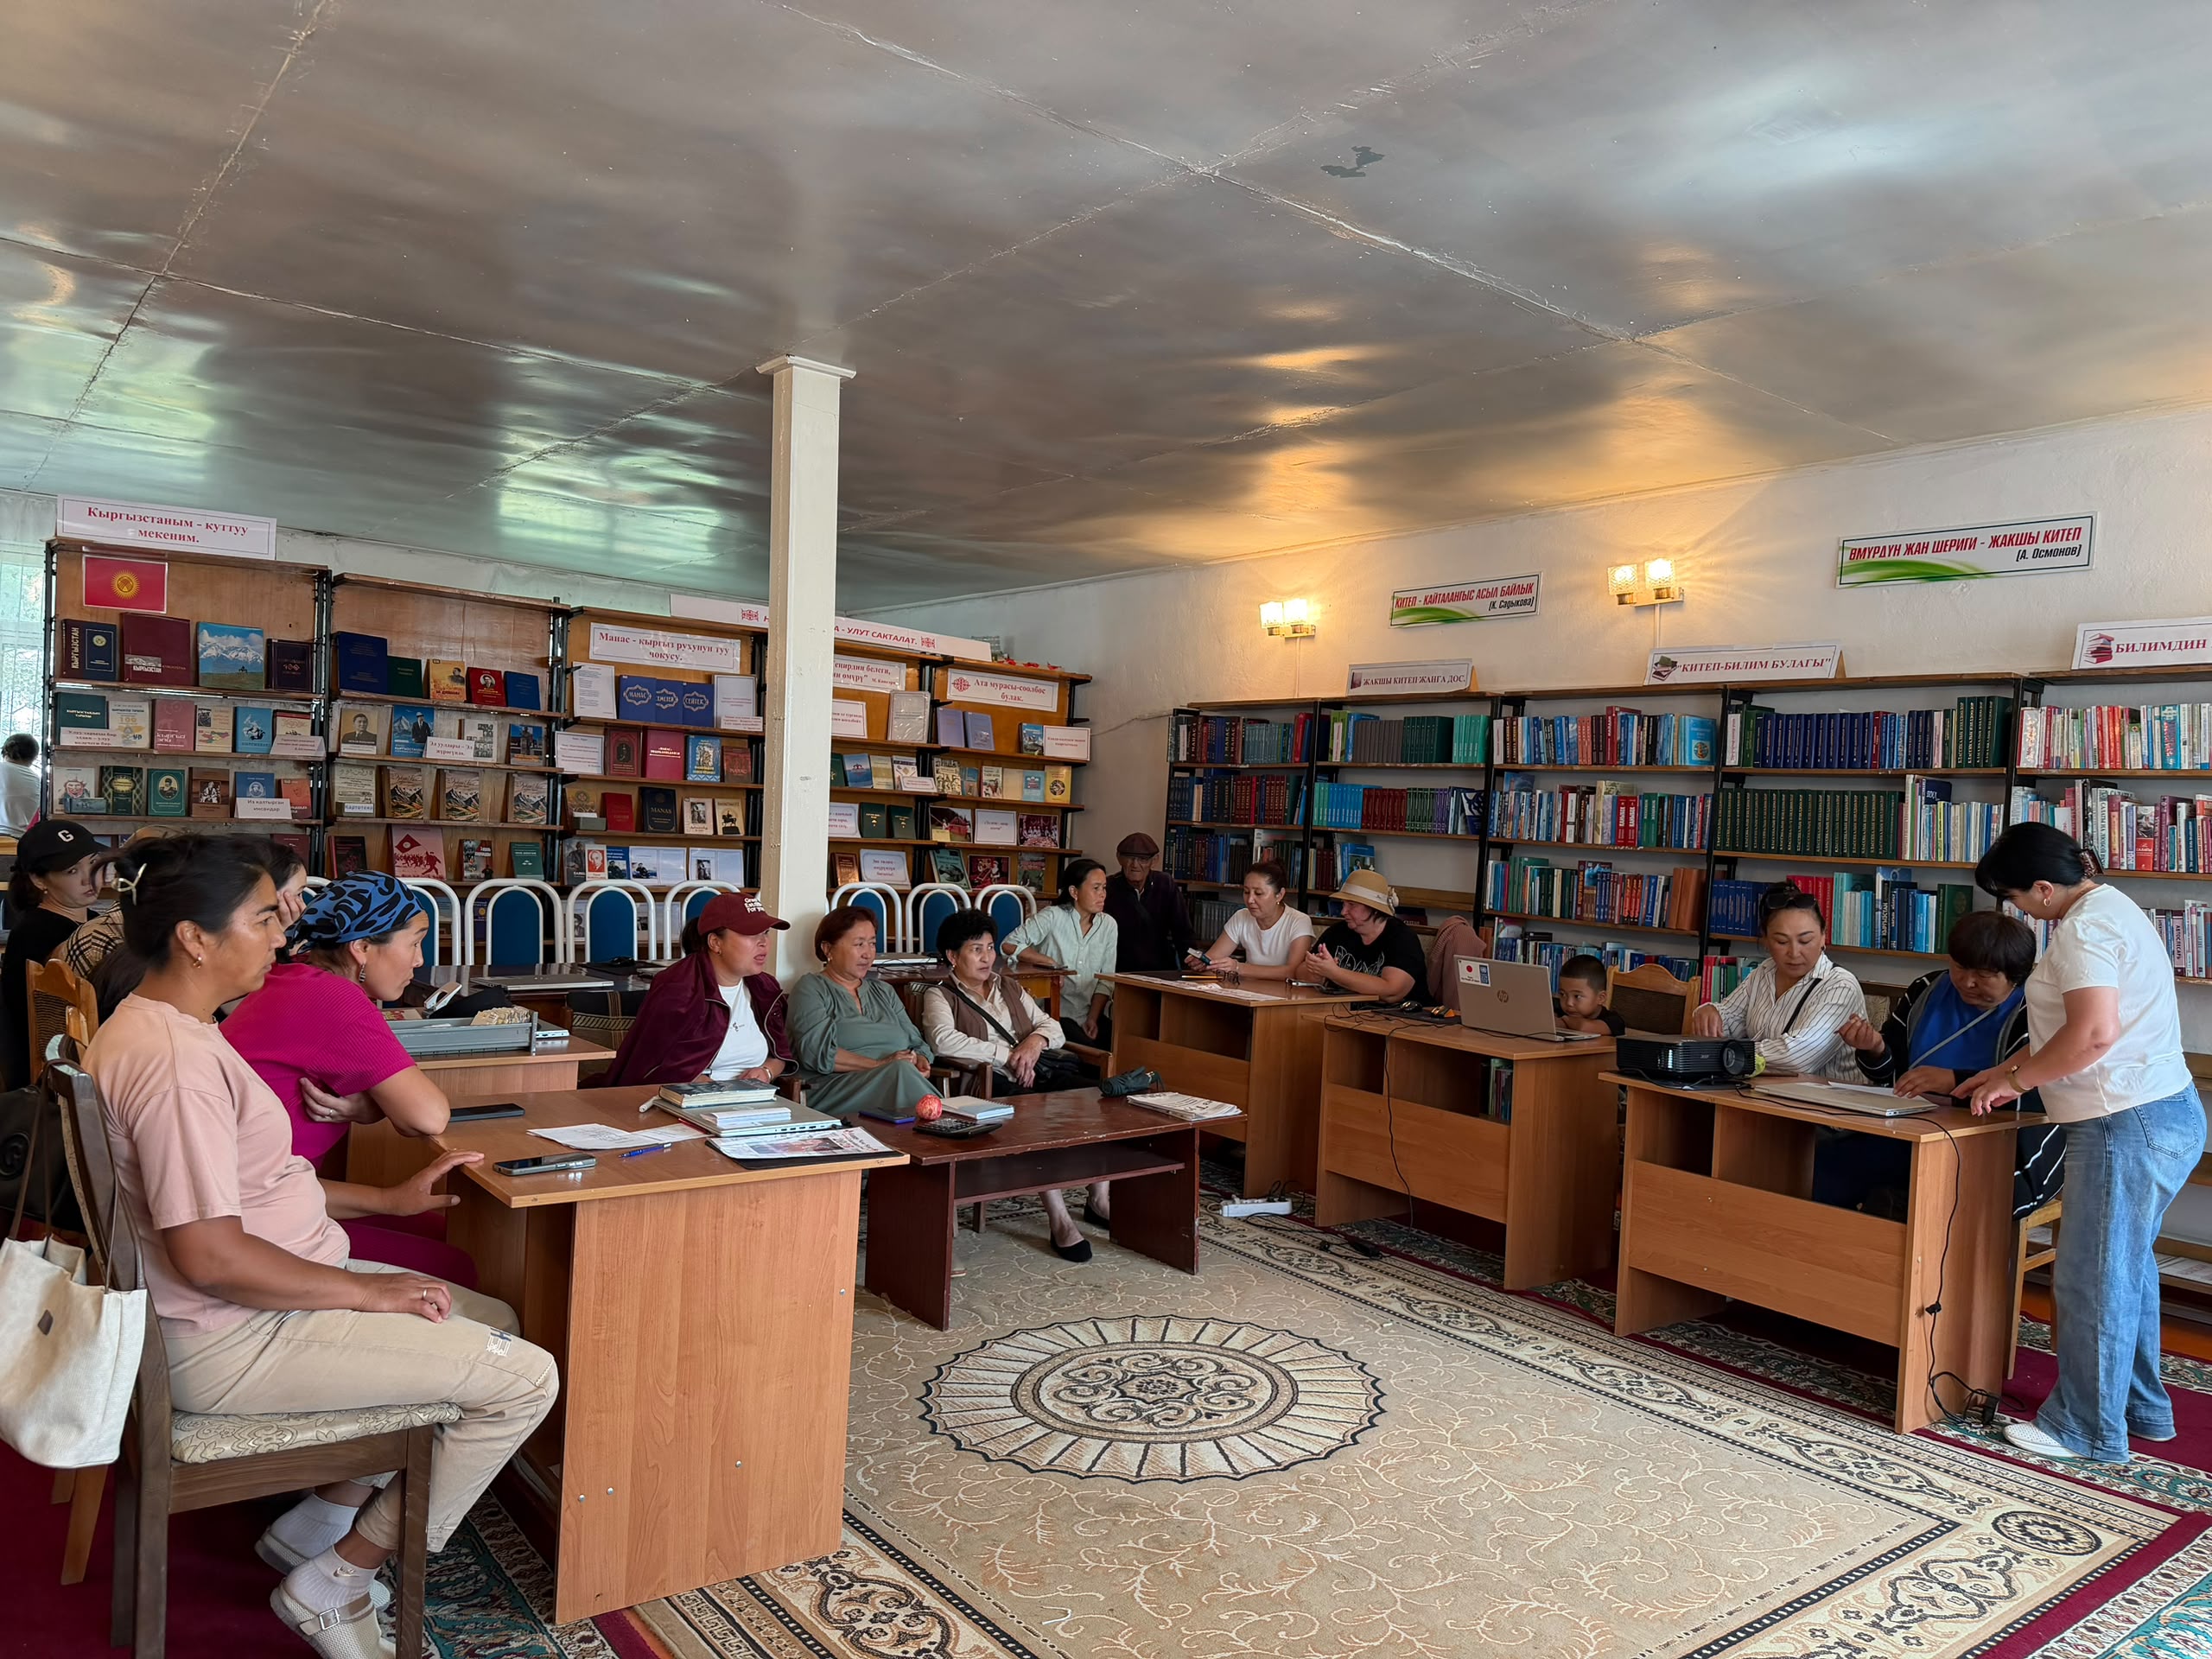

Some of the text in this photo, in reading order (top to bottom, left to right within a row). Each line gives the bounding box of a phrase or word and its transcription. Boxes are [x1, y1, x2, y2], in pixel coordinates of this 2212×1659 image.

[87, 506, 194, 529] Кыргызстаным
[205, 521, 249, 536] куттуу
[137, 529, 200, 543] мекеним.
[1848, 543, 1902, 562] ӨМҮРДҮН
[1904, 541, 1929, 556] ЖАН
[1931, 537, 1978, 554] ШЕРИГИ
[1987, 531, 2040, 550] ЖАКШЫ
[2042, 526, 2082, 544] КИТЕП
[1395, 595, 1418, 609] КИТЕП
[1423, 588, 1474, 606] КАЙТАЛАНГЫС
[1475, 587, 1499, 601] АСЫЛ
[1500, 582, 1535, 597] БАЙЛЫК
[847, 627, 870, 637] УЛУТ
[871, 631, 918, 645] САКТАЛАТ.
[71, 627, 79, 669] КЫРГЫЗСТАН
[599, 632, 631, 644] Манас
[639, 639, 675, 652] кыргыз
[677, 642, 713, 655] рухунун
[715, 645, 730, 656] туу
[2115, 639, 2207, 654] БИЛИМДИН
[649, 652, 683, 662] чокусу.
[1677, 658, 1831, 673] "КИТЕП-БИЛИМ БУЛАГЫ"
[974, 678, 988, 687] Ата
[1363, 677, 1392, 686] ЖАКШЫ
[1446, 674, 1466, 684] ДОС.
[1001, 691, 1024, 702] булак.
[57, 830, 74, 843] G
[1497, 990, 1509, 1003] hp
